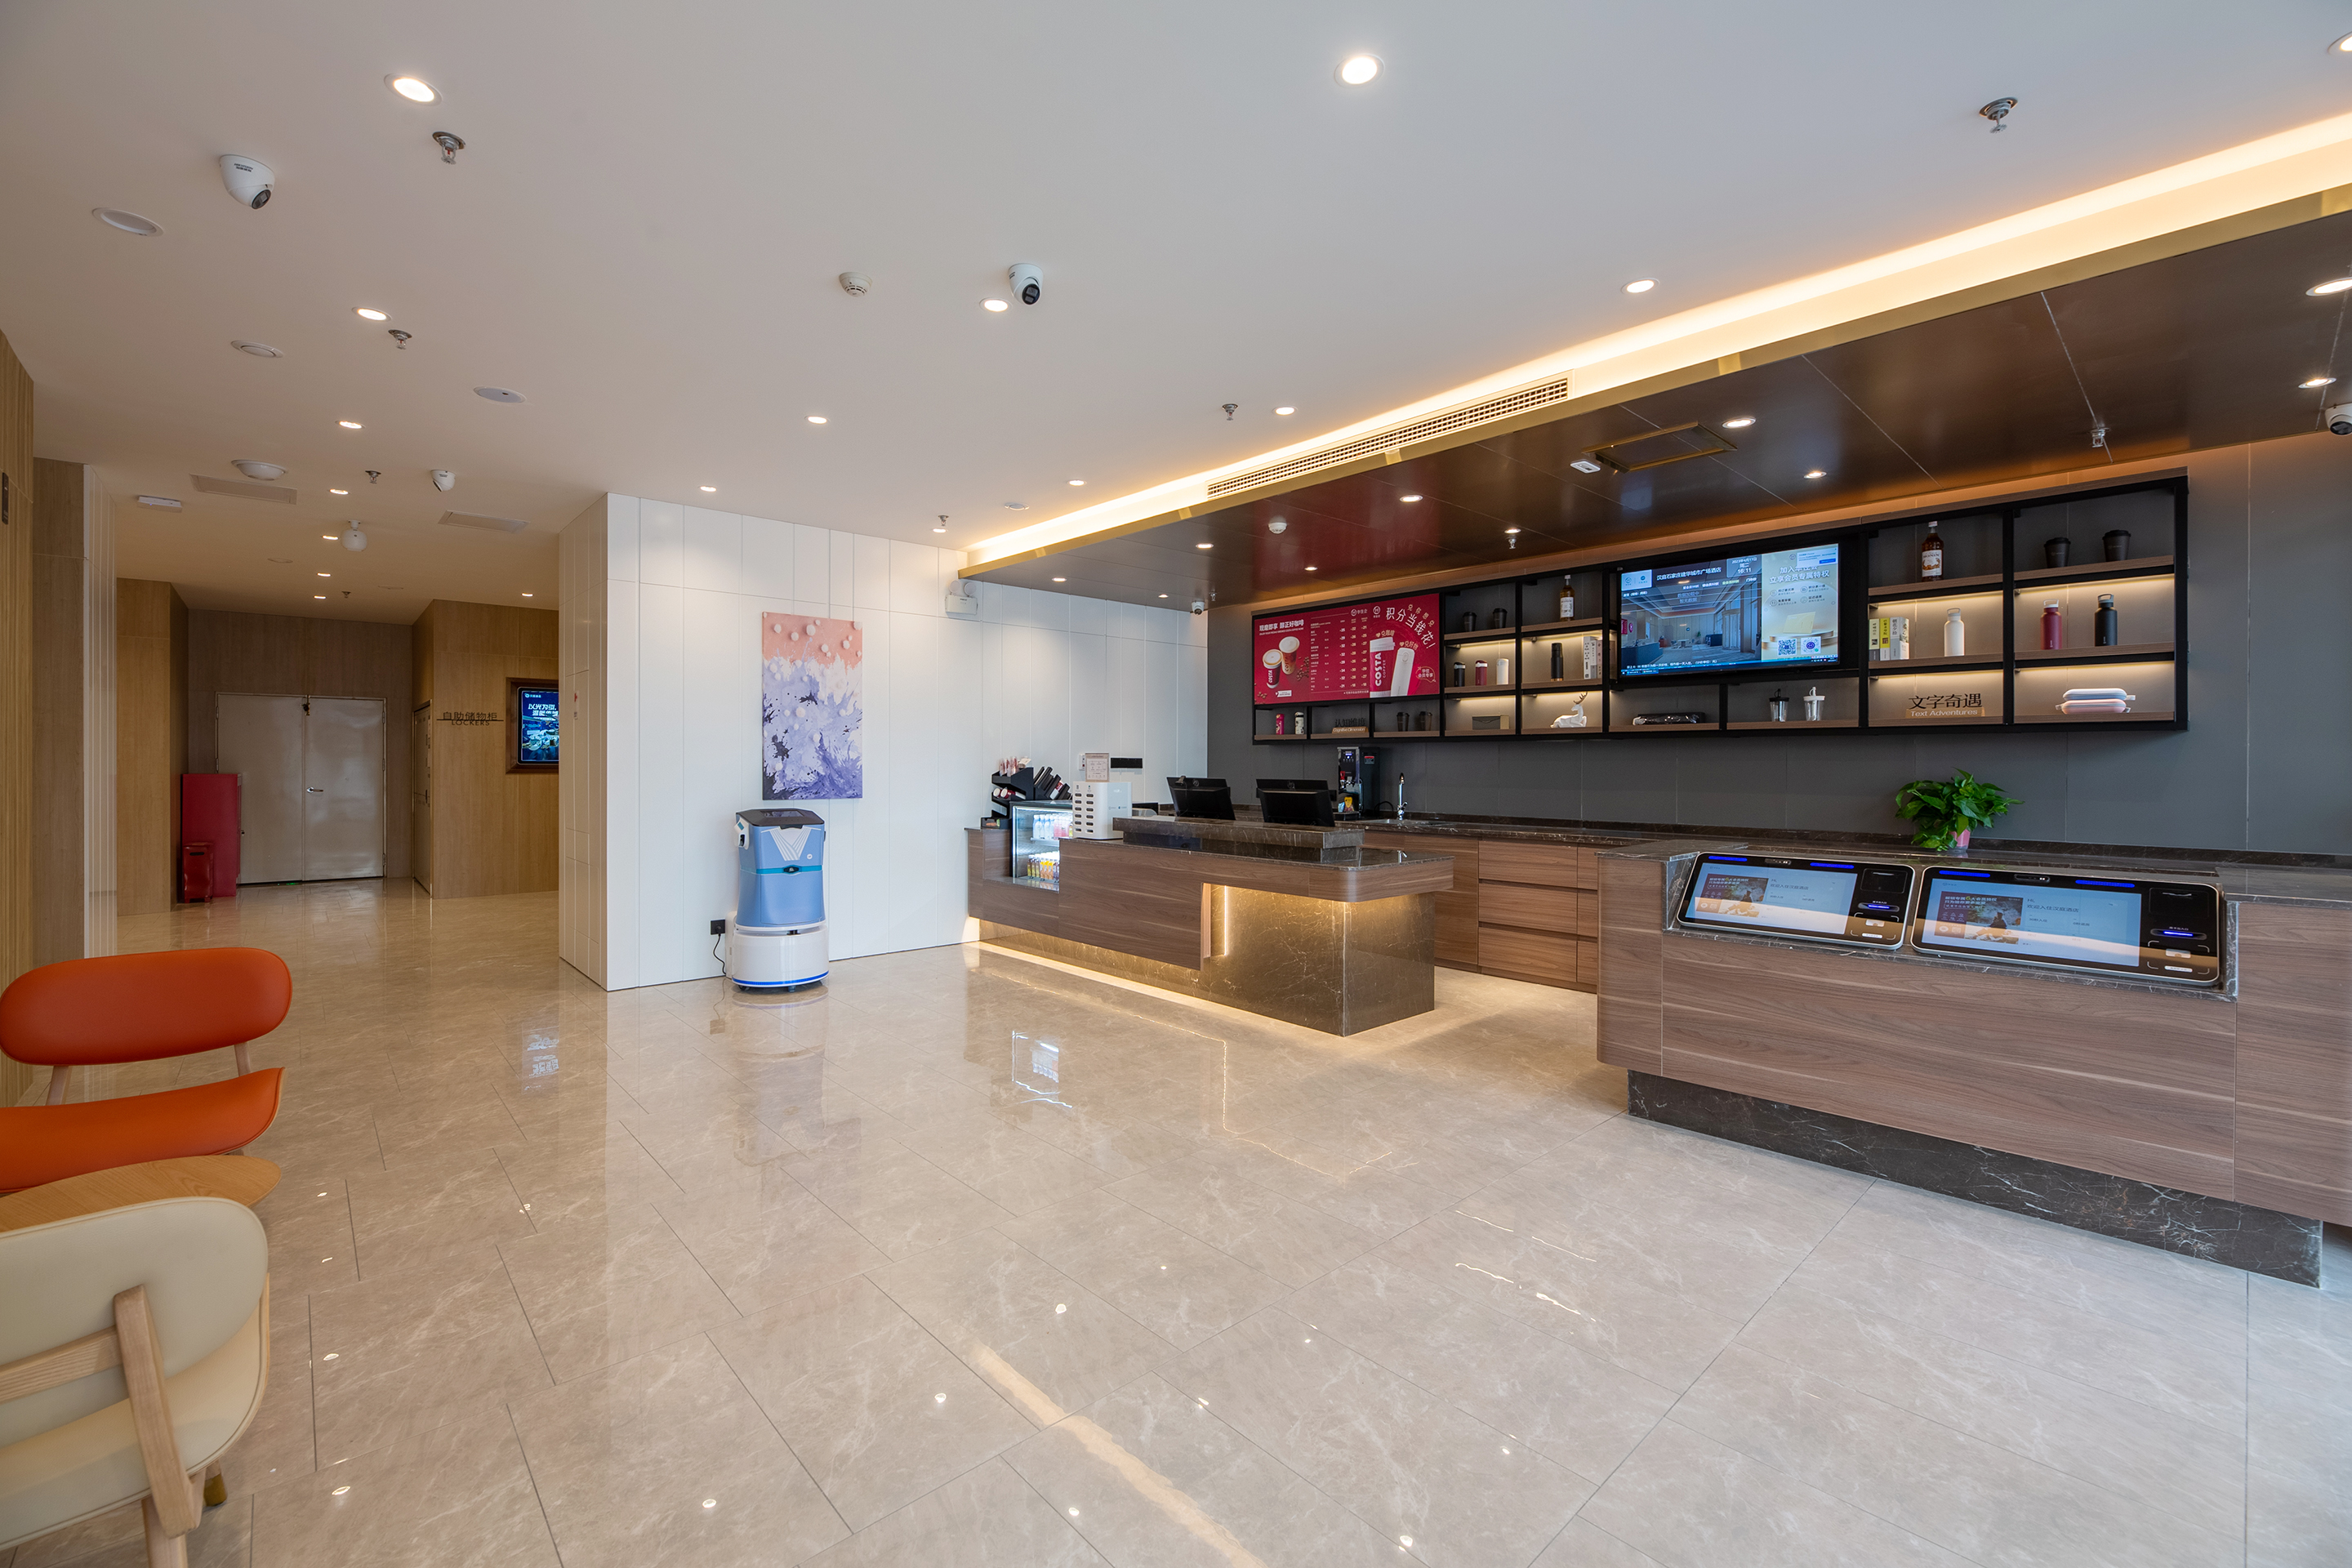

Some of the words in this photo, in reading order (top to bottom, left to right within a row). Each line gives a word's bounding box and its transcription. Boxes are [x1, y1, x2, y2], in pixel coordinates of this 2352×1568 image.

[1374, 653, 1383, 687] COSTA
[1909, 693, 1983, 710] 文字奇遇
[443, 711, 497, 721] 自助储物柜
[2026, 904, 2079, 913] 欢迎入住汉庭酒店
